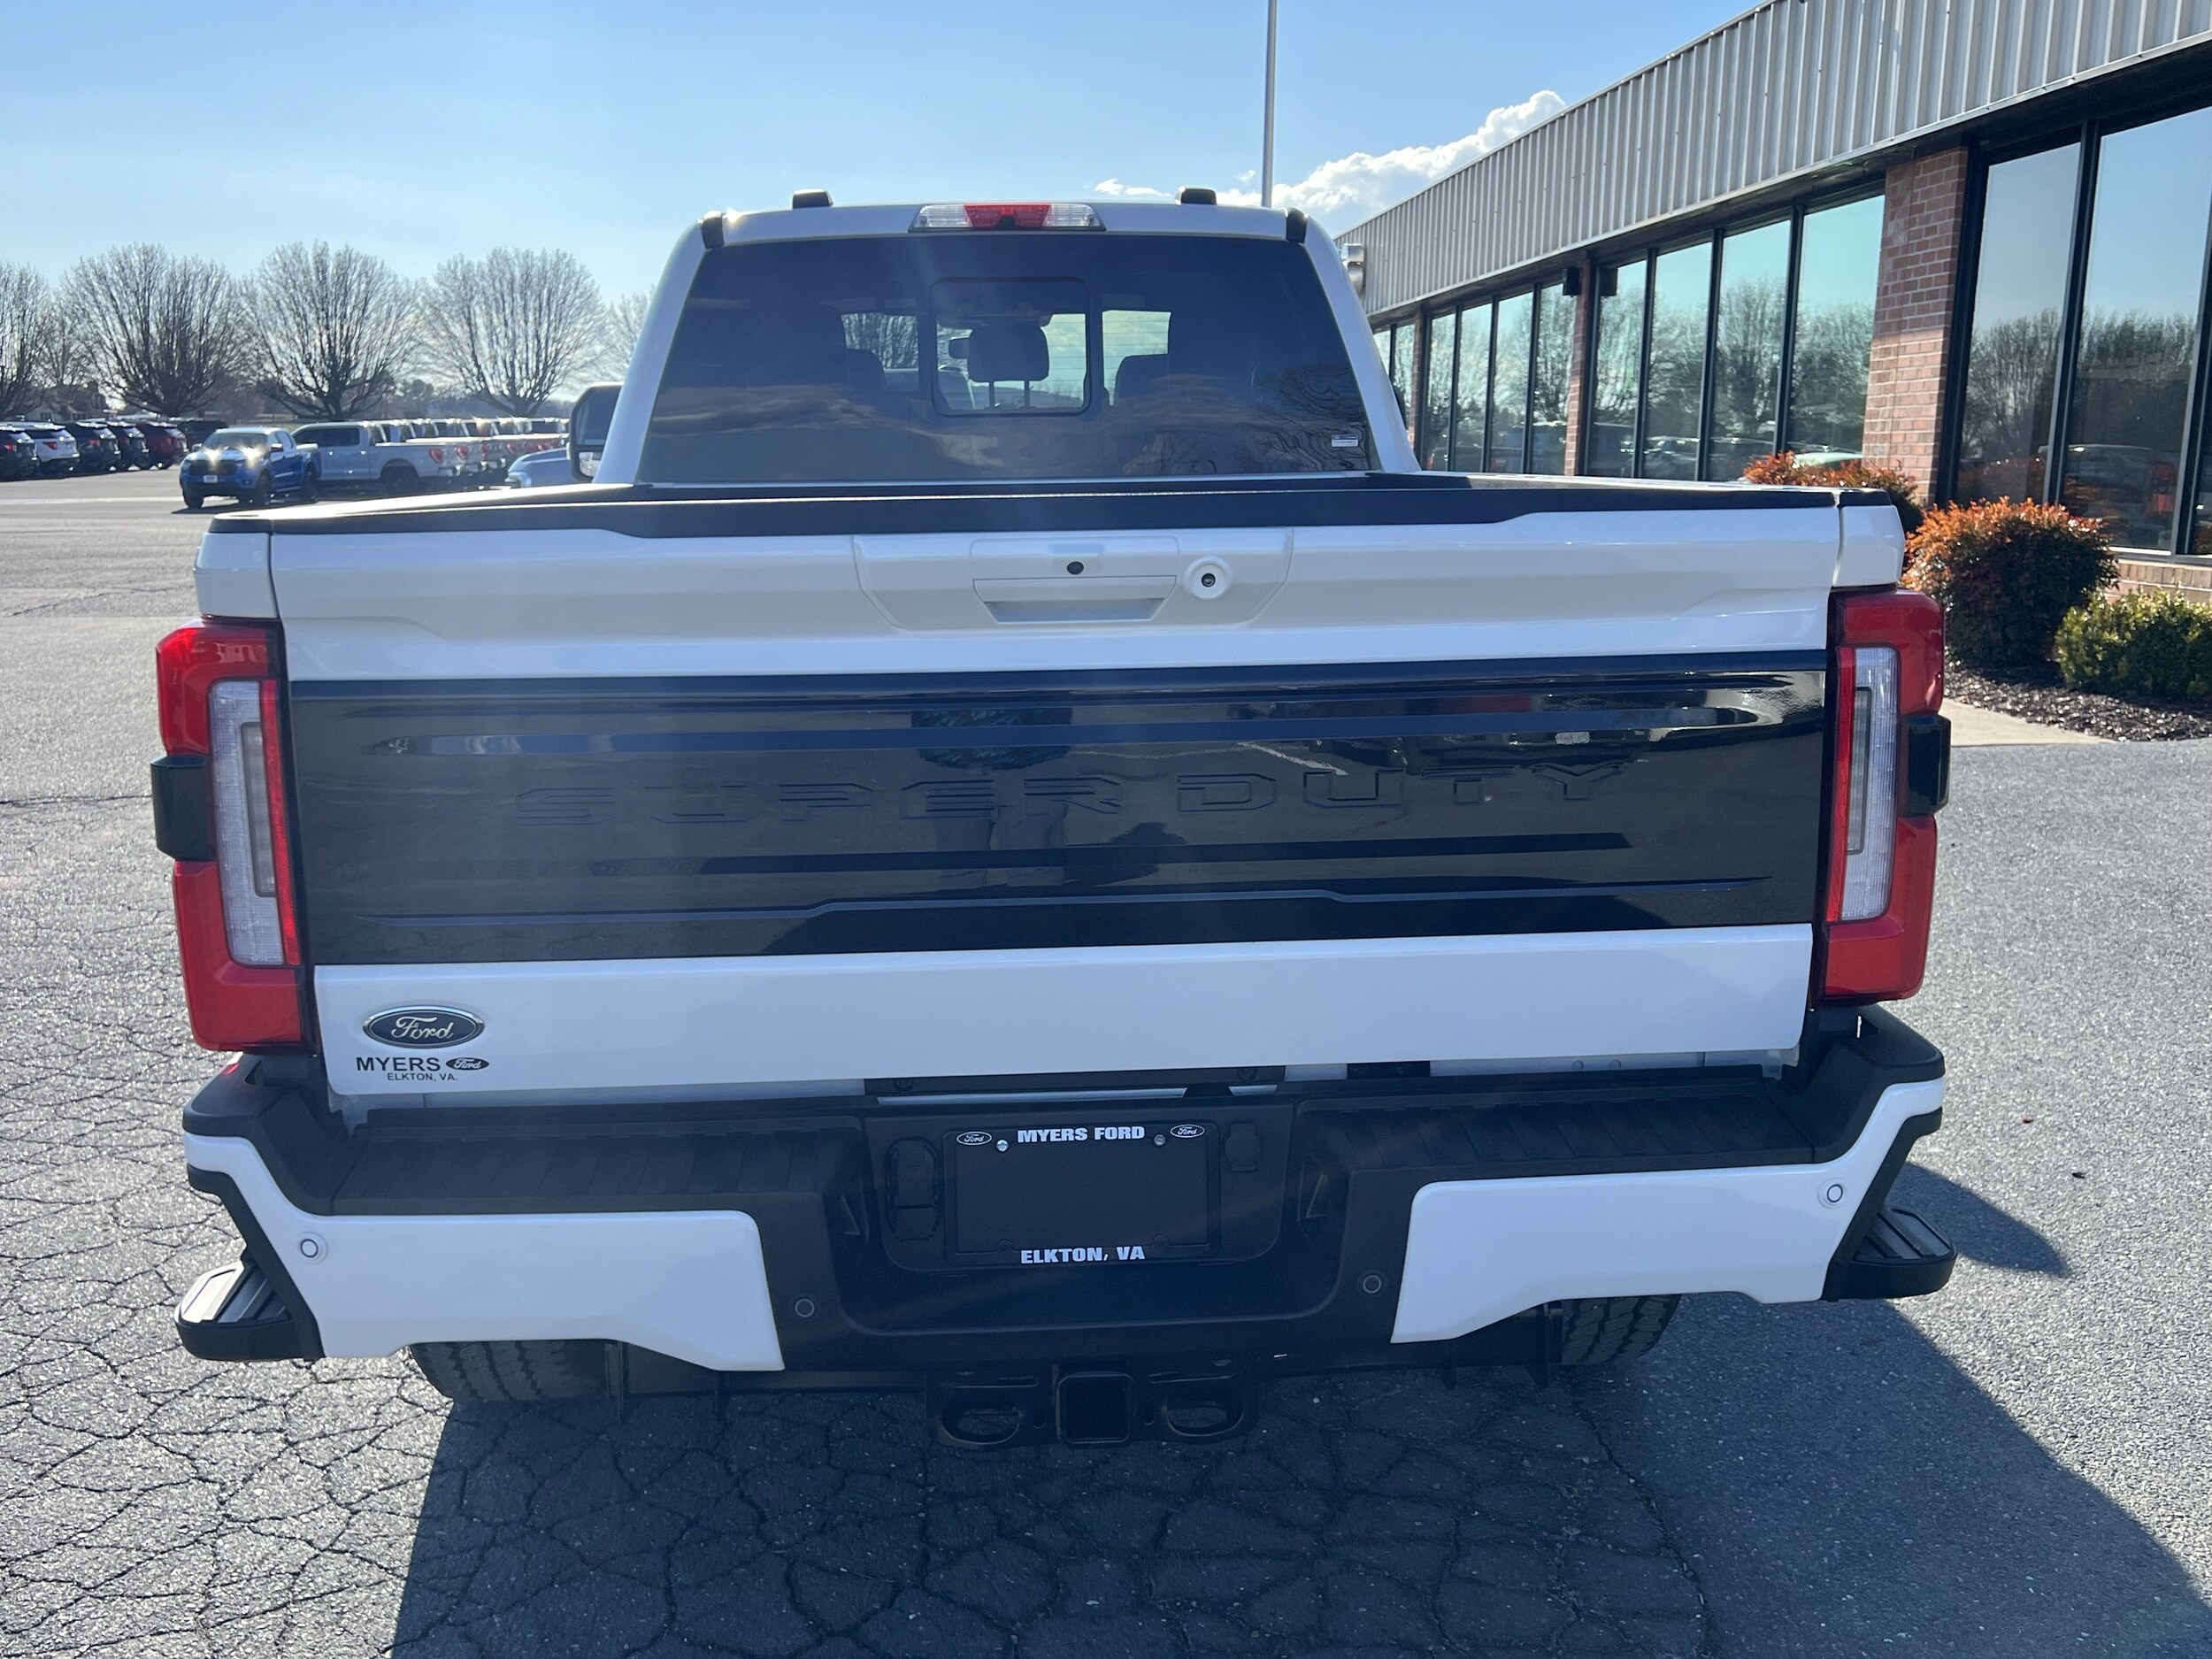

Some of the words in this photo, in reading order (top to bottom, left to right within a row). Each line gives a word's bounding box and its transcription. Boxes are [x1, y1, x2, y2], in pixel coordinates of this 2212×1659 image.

[390, 1016, 454, 1040] Ford
[356, 1057, 441, 1071] MYERS
[453, 1057, 482, 1070] Ford
[387, 1072, 437, 1081] ELKTON,
[1017, 1128, 1088, 1143] MYERS
[1094, 1125, 1145, 1141] FORD
[1020, 1247, 1110, 1264] ELKTON,
[1117, 1245, 1146, 1261] VA
